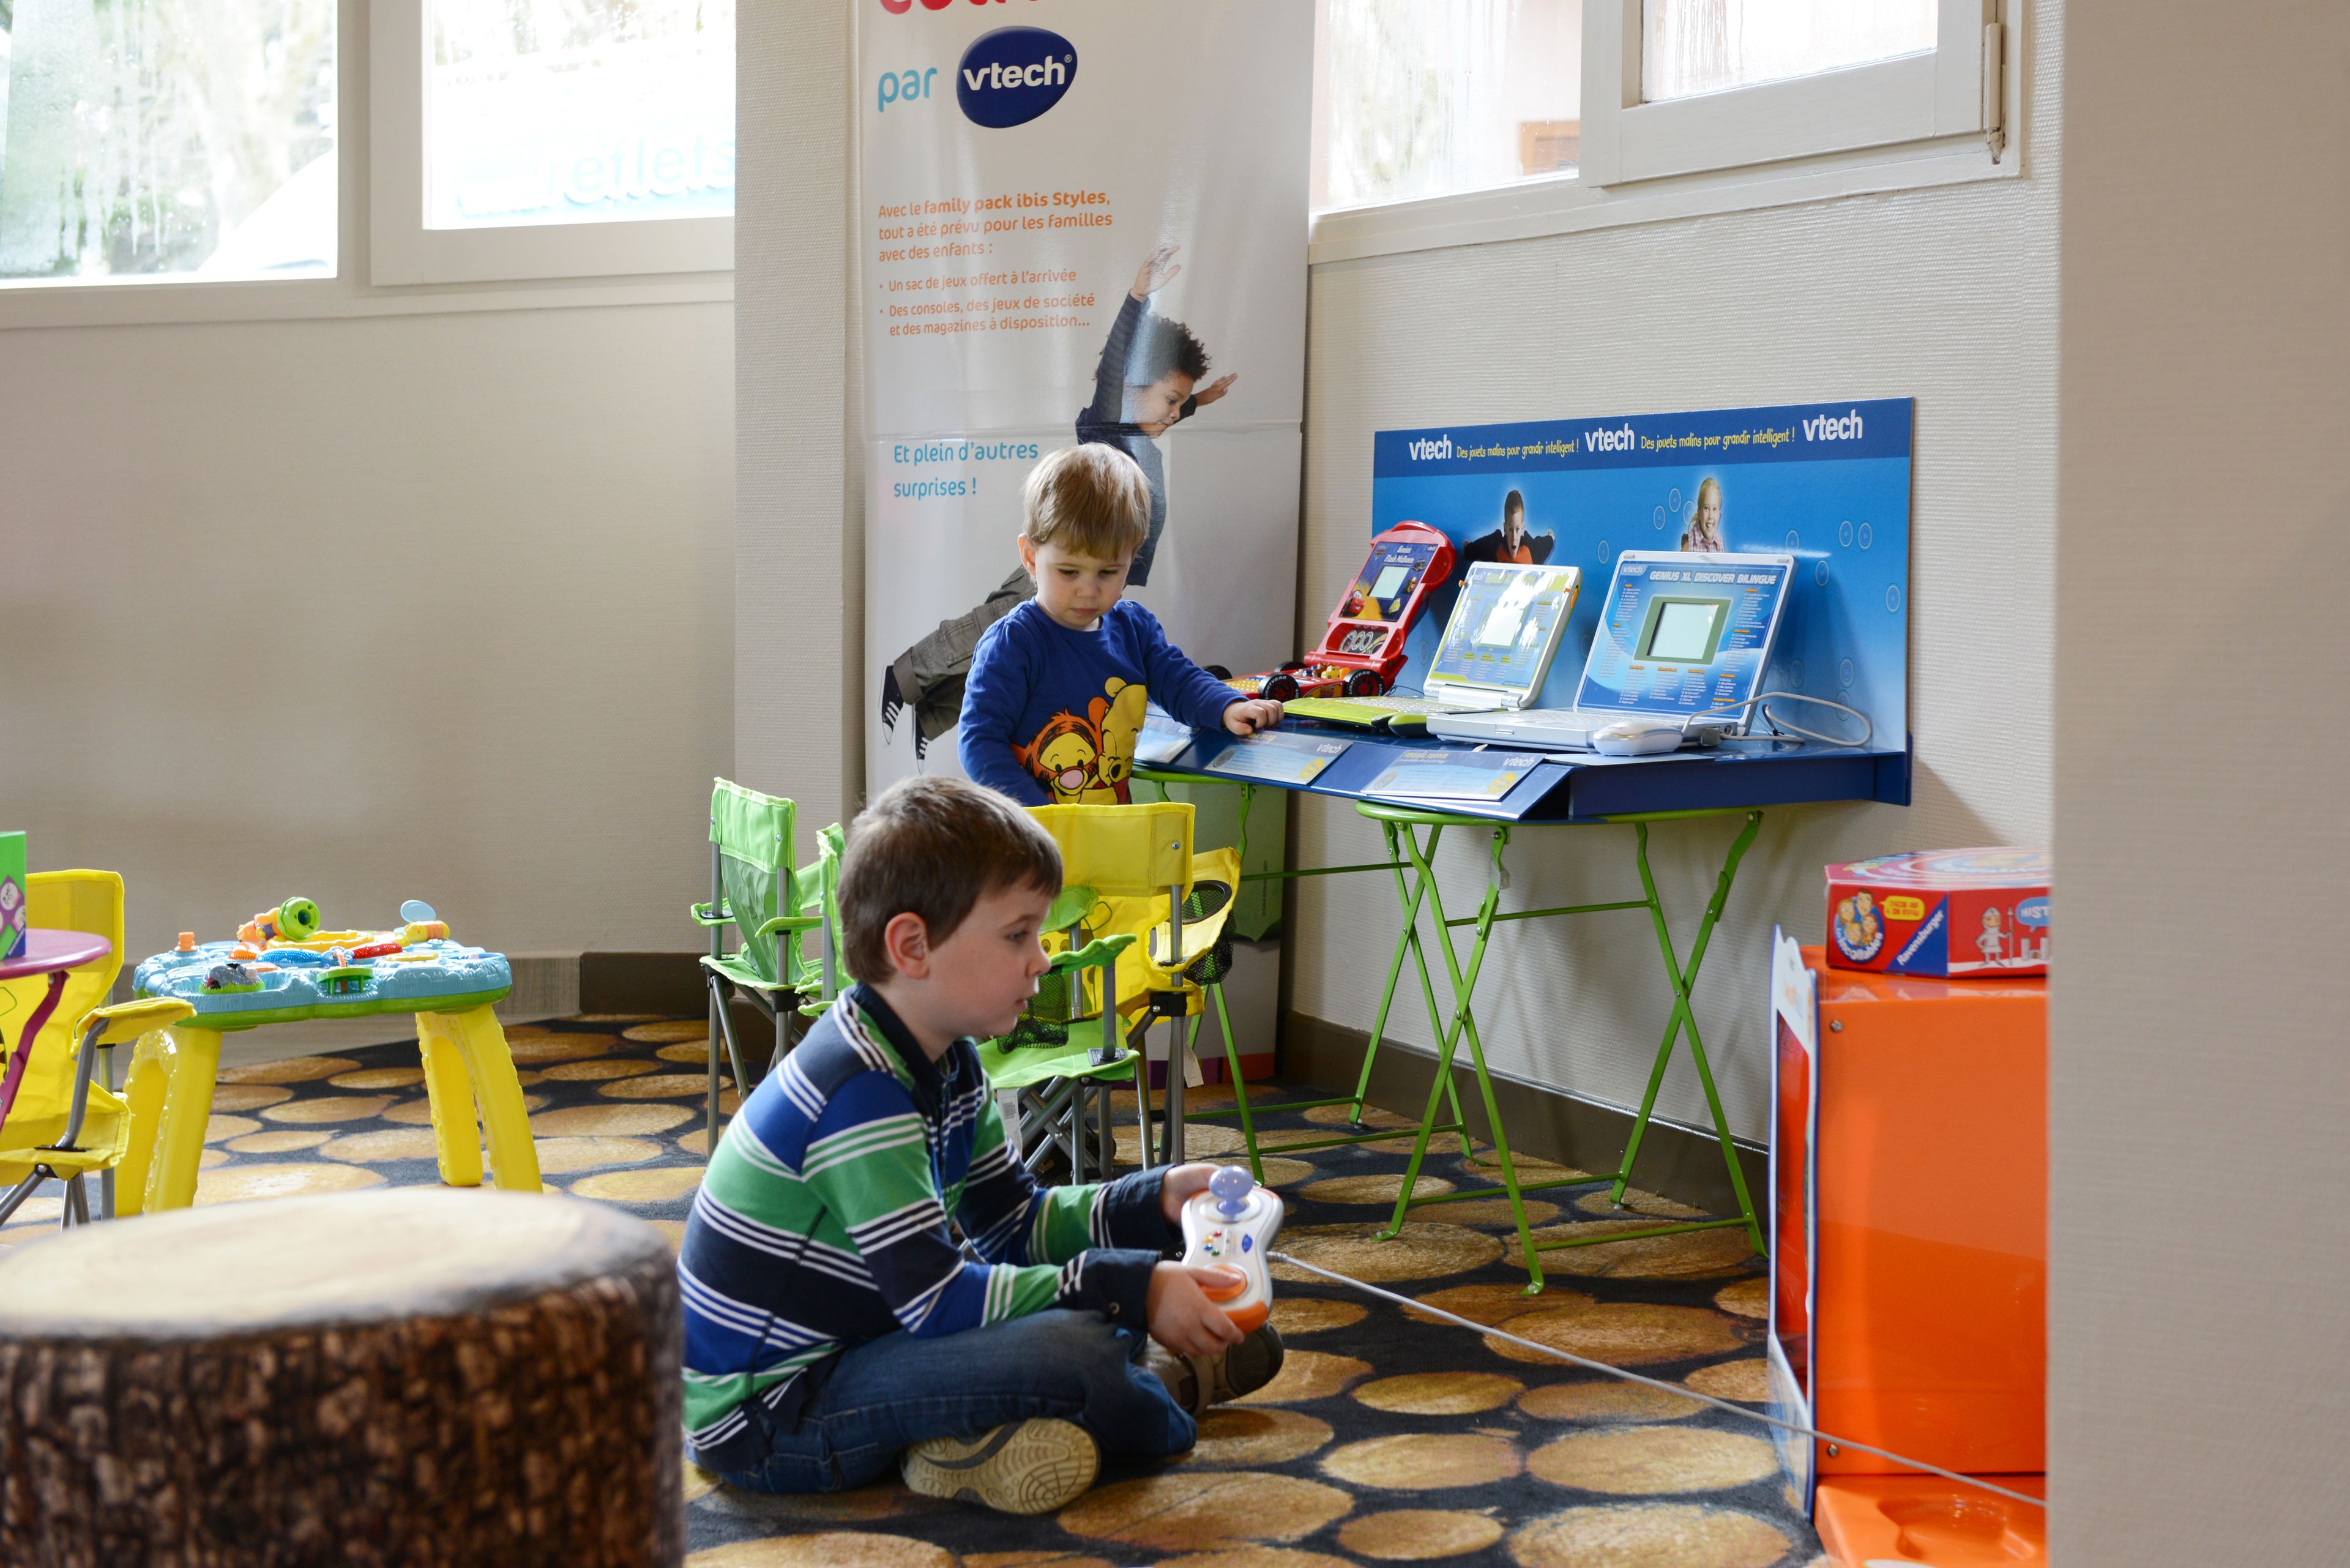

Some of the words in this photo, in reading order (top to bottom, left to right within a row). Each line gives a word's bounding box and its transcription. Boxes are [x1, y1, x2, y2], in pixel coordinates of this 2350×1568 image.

[878, 67, 938, 113] par
[878, 205, 907, 218] Avec
[910, 202, 921, 215] le
[925, 197, 971, 214] family
[974, 194, 1012, 214] pack
[1017, 192, 1048, 208] ibis
[1053, 190, 1110, 208] Styles,
[879, 226, 904, 240] tout
[907, 226, 914, 237] a
[917, 221, 937, 237] été
[941, 219, 979, 237] prévu
[984, 219, 1018, 235] pour
[1023, 215, 1044, 230] les
[1048, 212, 1113, 228] familles
[879, 249, 906, 262] avec
[908, 245, 930, 259] des
[933, 242, 985, 257] enfants
[889, 280, 903, 291] Un
[906, 280, 922, 291] sac
[925, 277, 939, 289] de
[941, 276, 967, 291] jeux
[971, 272, 1007, 286] offert
[1010, 271, 1018, 284] à
[889, 304, 908, 317] Des
[911, 301, 963, 315] consoles,
[967, 299, 989, 312] des
[991, 298, 1020, 313] jeux
[1023, 296, 1040, 308] de
[1044, 293, 1095, 307] société
[890, 324, 900, 336] et
[903, 323, 921, 335] des
[924, 319, 986, 335] magazines
[990, 317, 996, 330] à
[1409, 434, 1452, 460] vtech
[1457, 446, 1468, 458] Des
[1469, 445, 1486, 460] jouets
[1487, 443, 1505, 457] malins
[1507, 446, 1521, 458] pour
[1522, 442, 1543, 459] grandir
[1546, 439, 1575, 458] intelligent
[1585, 423, 1635, 452] vtech
[1641, 435, 1655, 449] Des
[1655, 435, 1677, 452] jouets
[1679, 432, 1701, 447] malins
[1704, 435, 1720, 450] pour
[1723, 430, 1750, 450] grandir
[1753, 428, 1789, 447] intelligent
[1802, 409, 1863, 441] vtech
[894, 446, 909, 463] Et
[914, 443, 953, 466] plein
[893, 477, 966, 500] surprises
[1649, 571, 1680, 582] GENIUS
[1681, 572, 1692, 582] XL
[1695, 572, 1736, 583] DISCOVER
[1736, 574, 1777, 584] BILINGUE
[1264, 676, 1288, 700] LIGHTYEAR
[1349, 671, 1371, 695] LIGHTYEAR
[1316, 743, 1343, 753] vtech
[1502, 758, 1535, 767] vtech
[1897, 909, 1944, 966] Ravensburger
